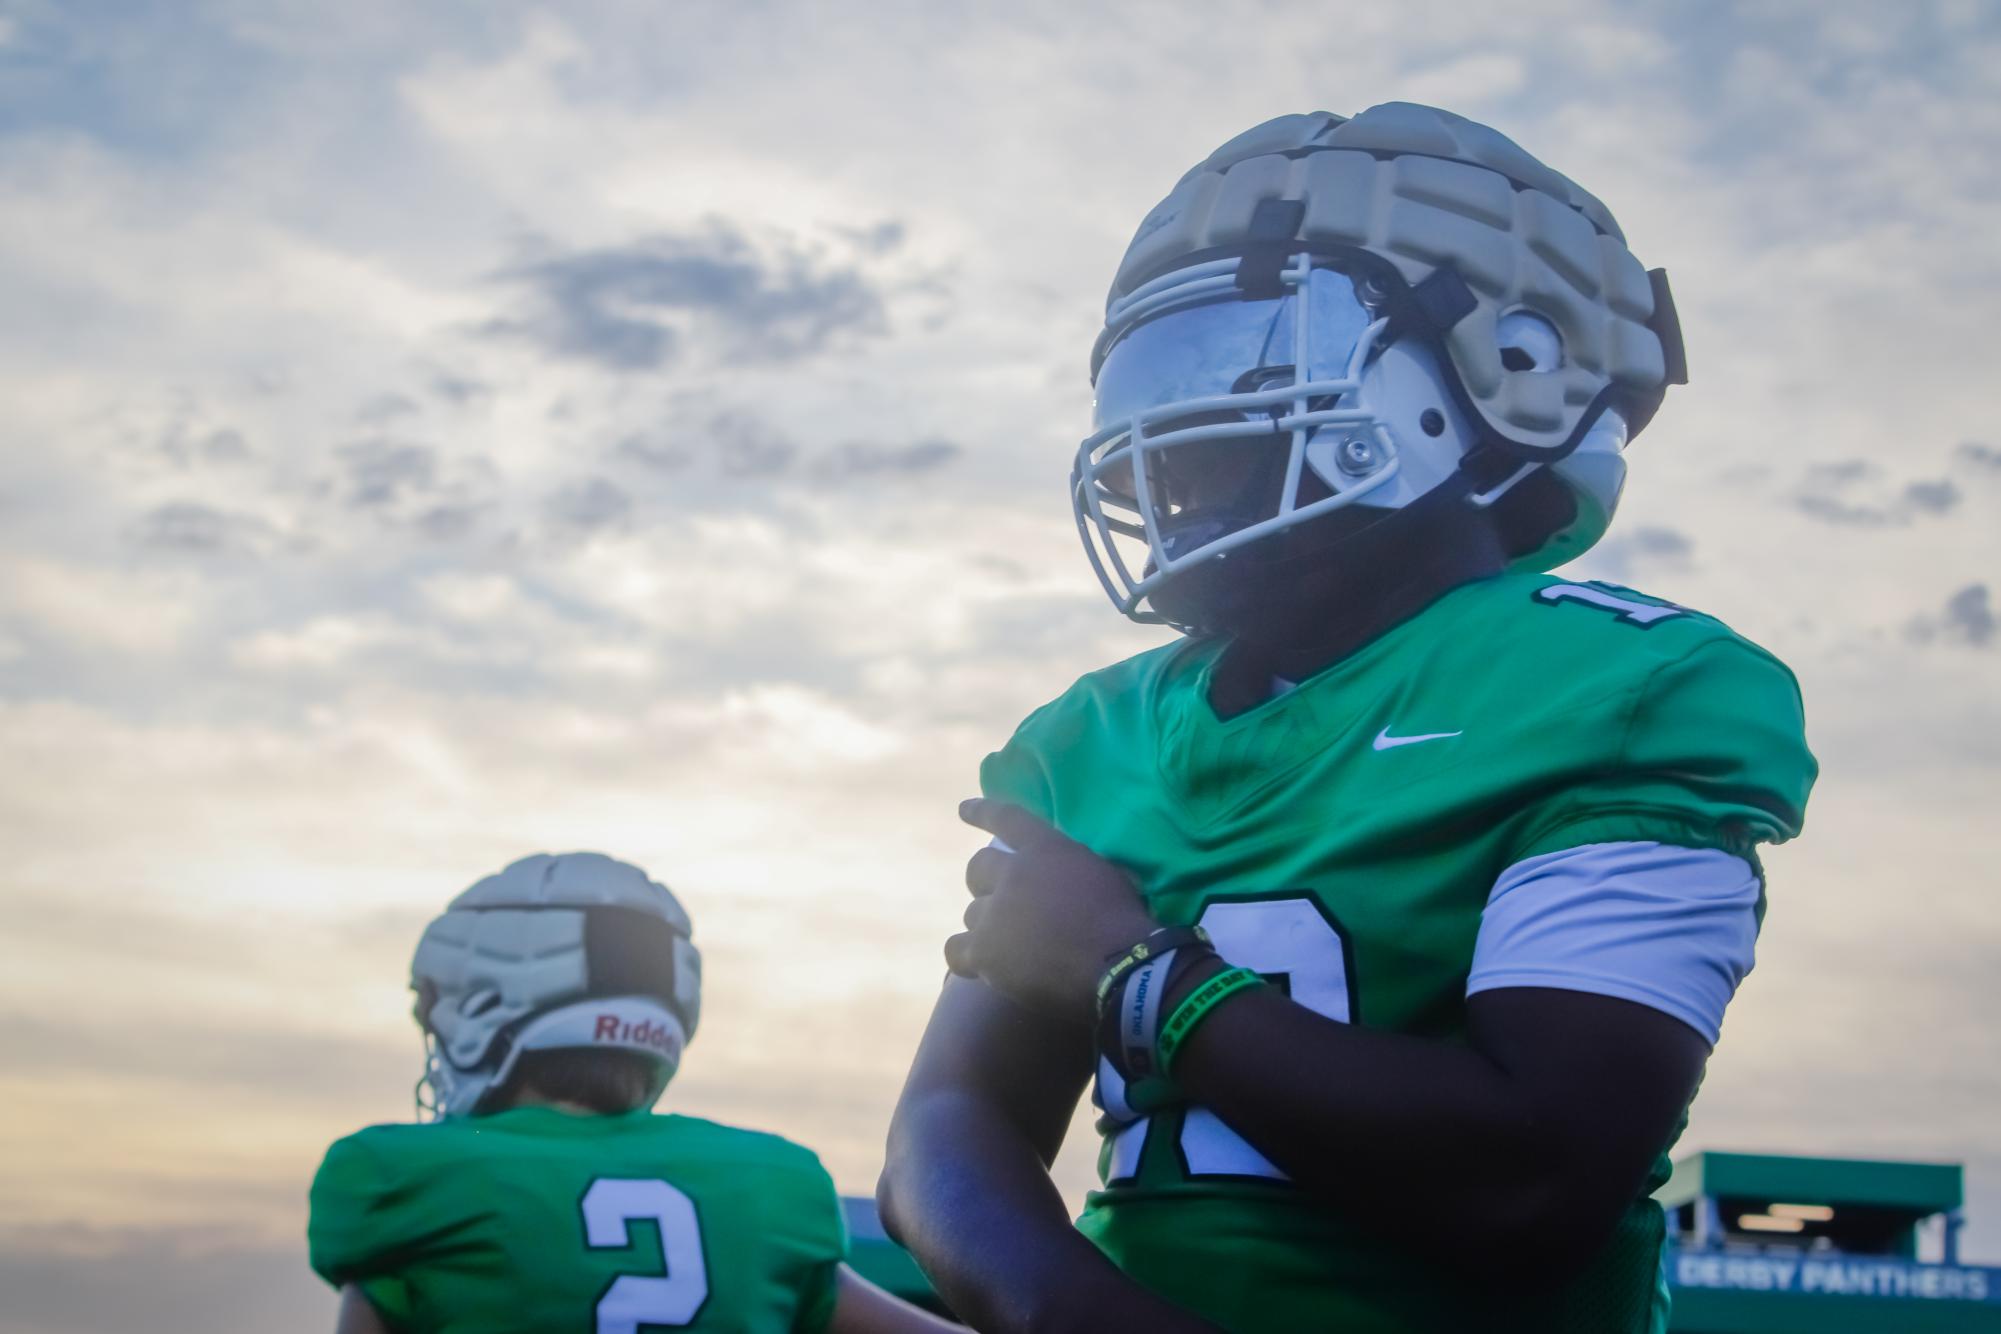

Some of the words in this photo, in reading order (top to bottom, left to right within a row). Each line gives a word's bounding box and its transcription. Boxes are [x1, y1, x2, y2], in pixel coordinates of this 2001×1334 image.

[1537, 580, 1684, 626] 1
[1132, 970, 1153, 1035] OKLAHOMA
[1171, 1003, 1198, 1030] WIN
[1194, 981, 1223, 1005] THE
[1221, 971, 1246, 987] DAY
[581, 1178, 708, 1334] 2
[1677, 1254, 1796, 1290] DERBY
[1801, 1260, 1988, 1300] PANTHERS
